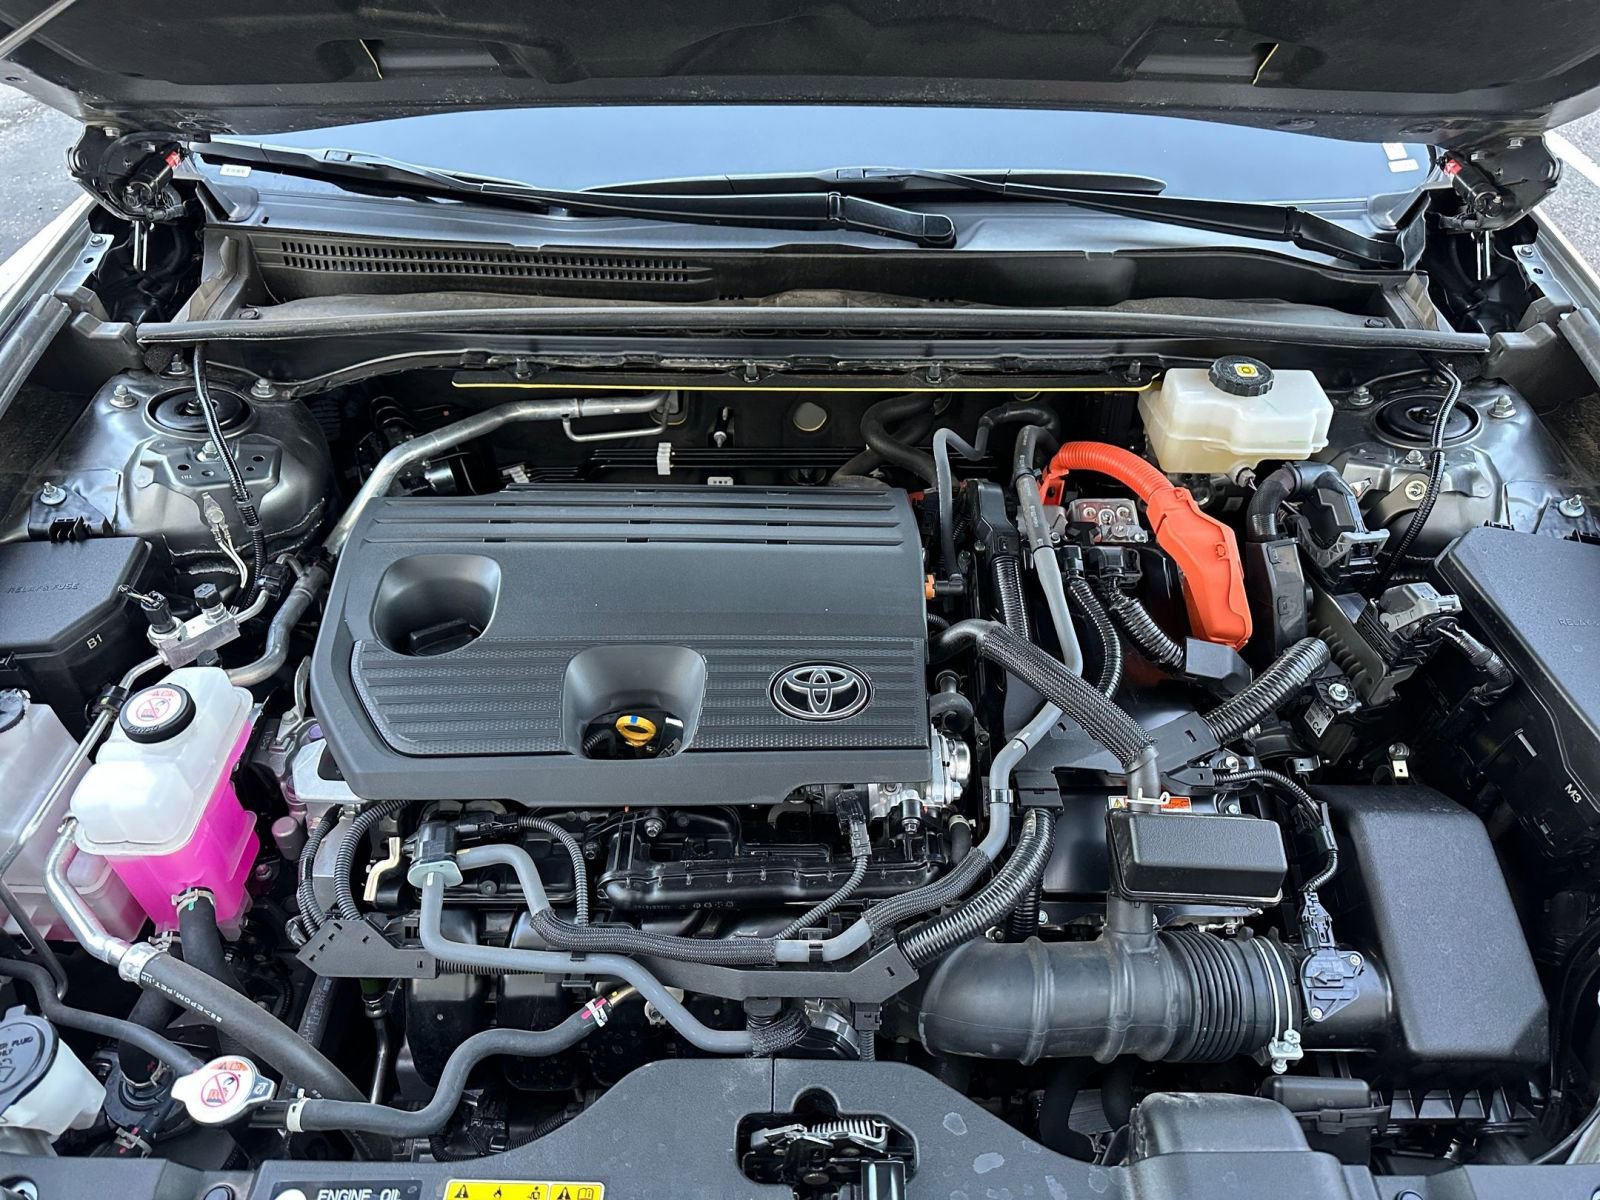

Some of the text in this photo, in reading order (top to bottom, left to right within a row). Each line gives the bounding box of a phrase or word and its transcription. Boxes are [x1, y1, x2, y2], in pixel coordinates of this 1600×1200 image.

[86, 633, 103, 650] B1
[1564, 783, 1582, 803] M3
[316, 1188, 402, 1200] ENGINE OIL
